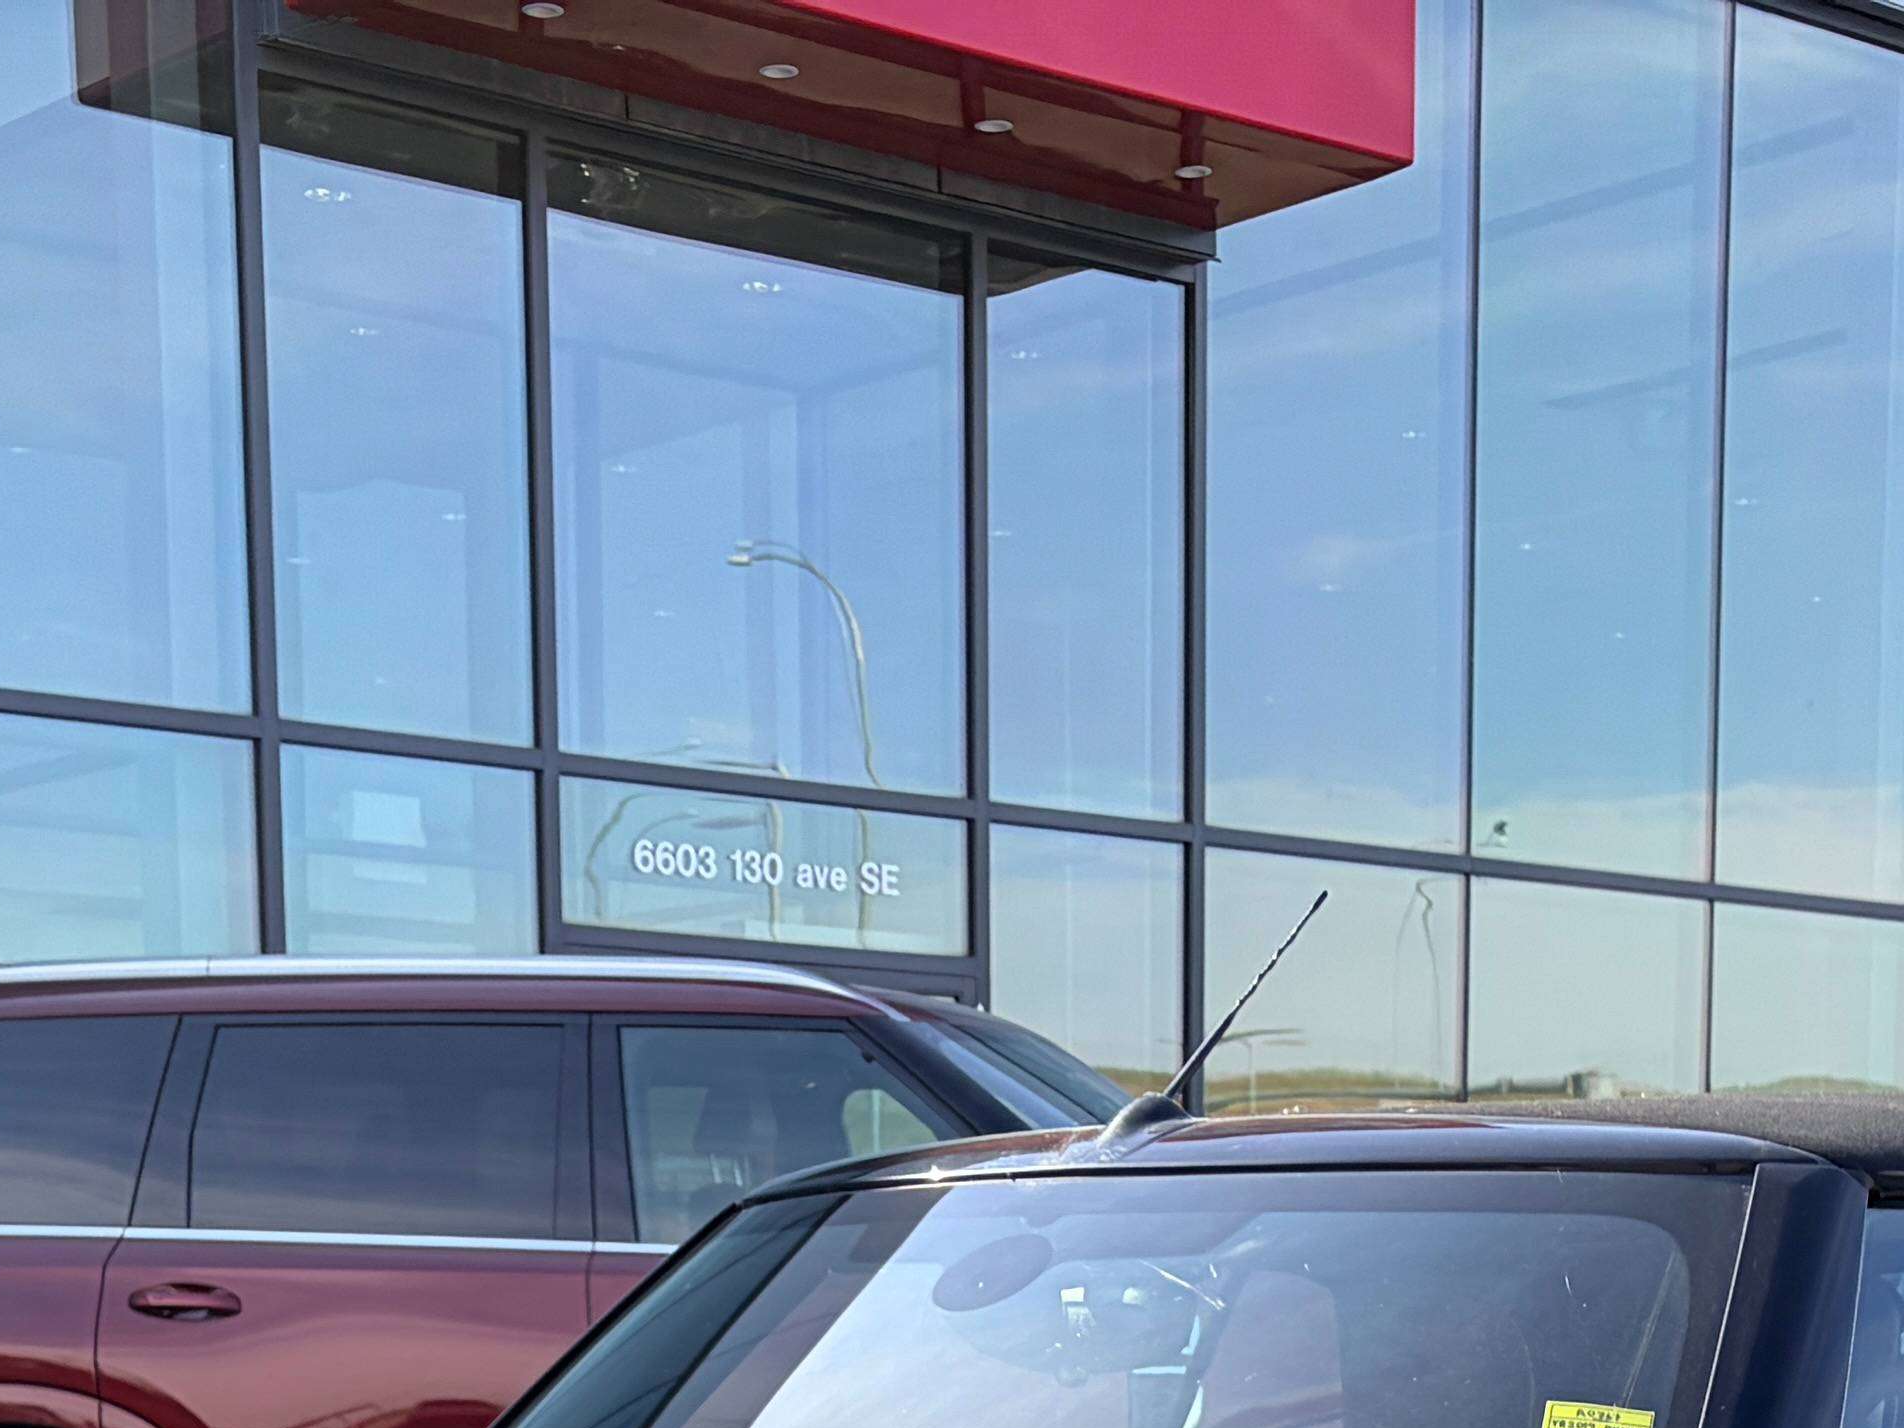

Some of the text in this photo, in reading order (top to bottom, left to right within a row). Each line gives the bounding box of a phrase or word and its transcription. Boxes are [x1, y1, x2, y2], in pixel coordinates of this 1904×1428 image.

[633, 838, 901, 897] 6603 130 ave SE
